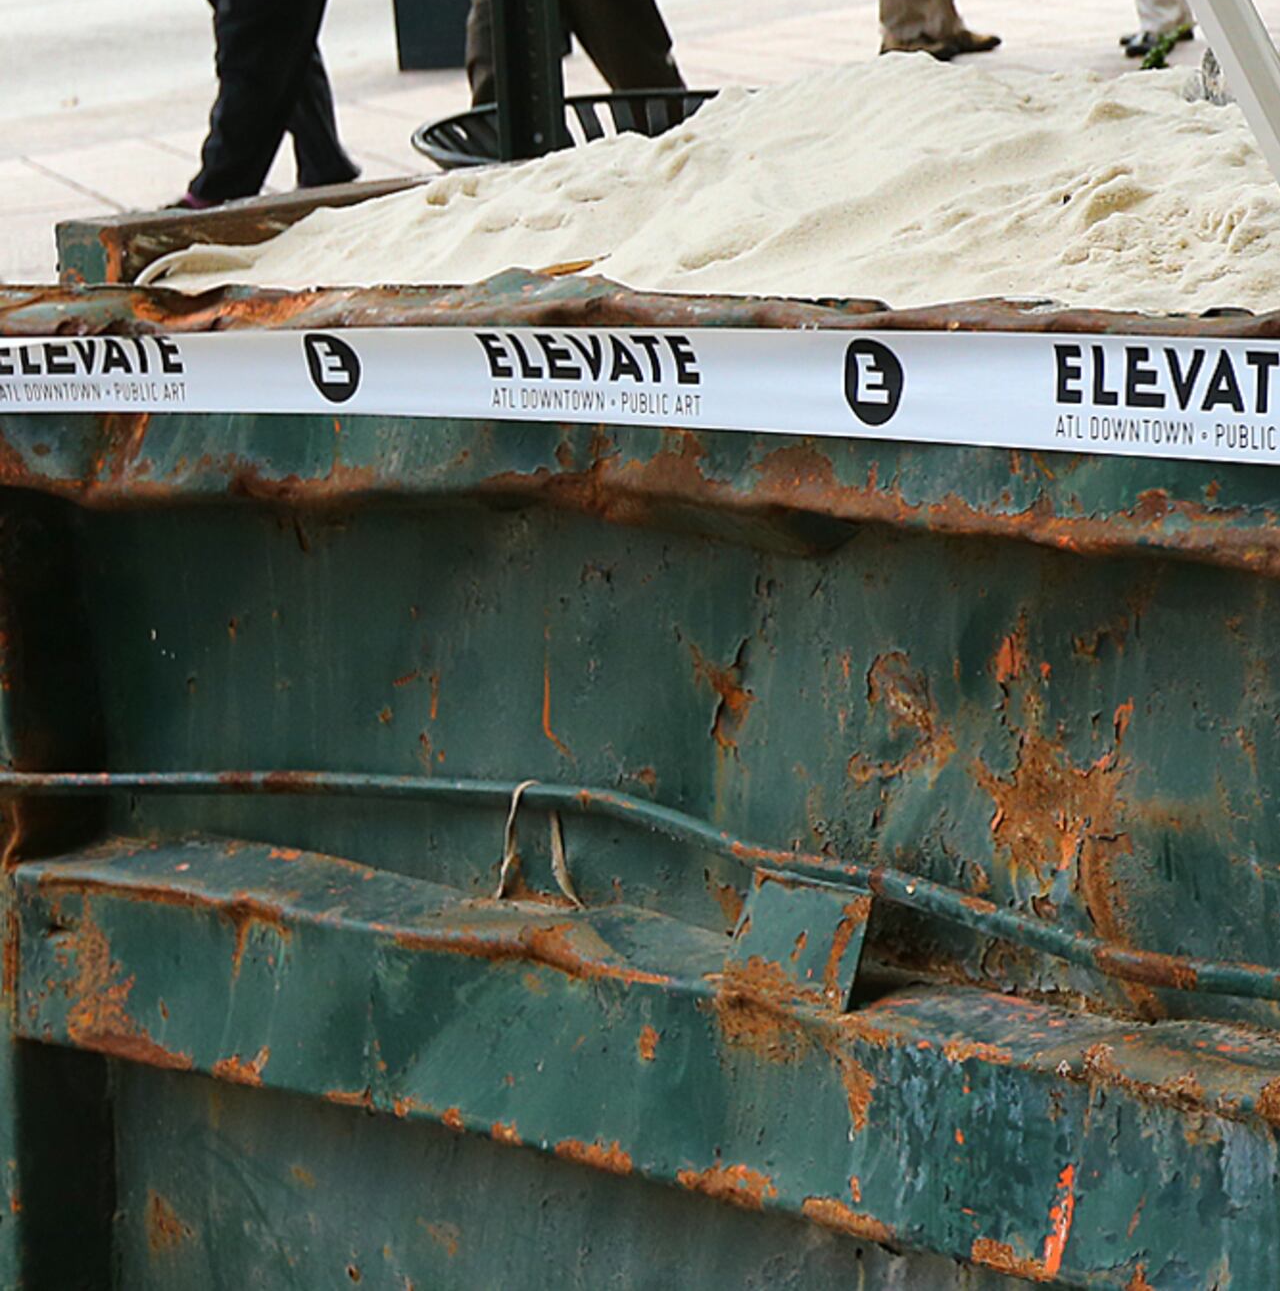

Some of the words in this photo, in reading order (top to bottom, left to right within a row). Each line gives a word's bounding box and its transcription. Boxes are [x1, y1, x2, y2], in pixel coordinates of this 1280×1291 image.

[475, 333, 700, 385] ELEVATE
[24, 382, 101, 402] DOWNTOWN
[113, 382, 158, 402] PUBLIC
[162, 383, 187, 402] ART
[492, 388, 515, 409] ATL
[521, 389, 605, 412] DOWNTOWN
[621, 392, 669, 415] PUBLIC
[675, 395, 701, 416] ART
[1056, 415, 1083, 439] ATL
[1090, 416, 1194, 445] DOWNTOWN
[1215, 424, 1277, 451] PUBLIC
